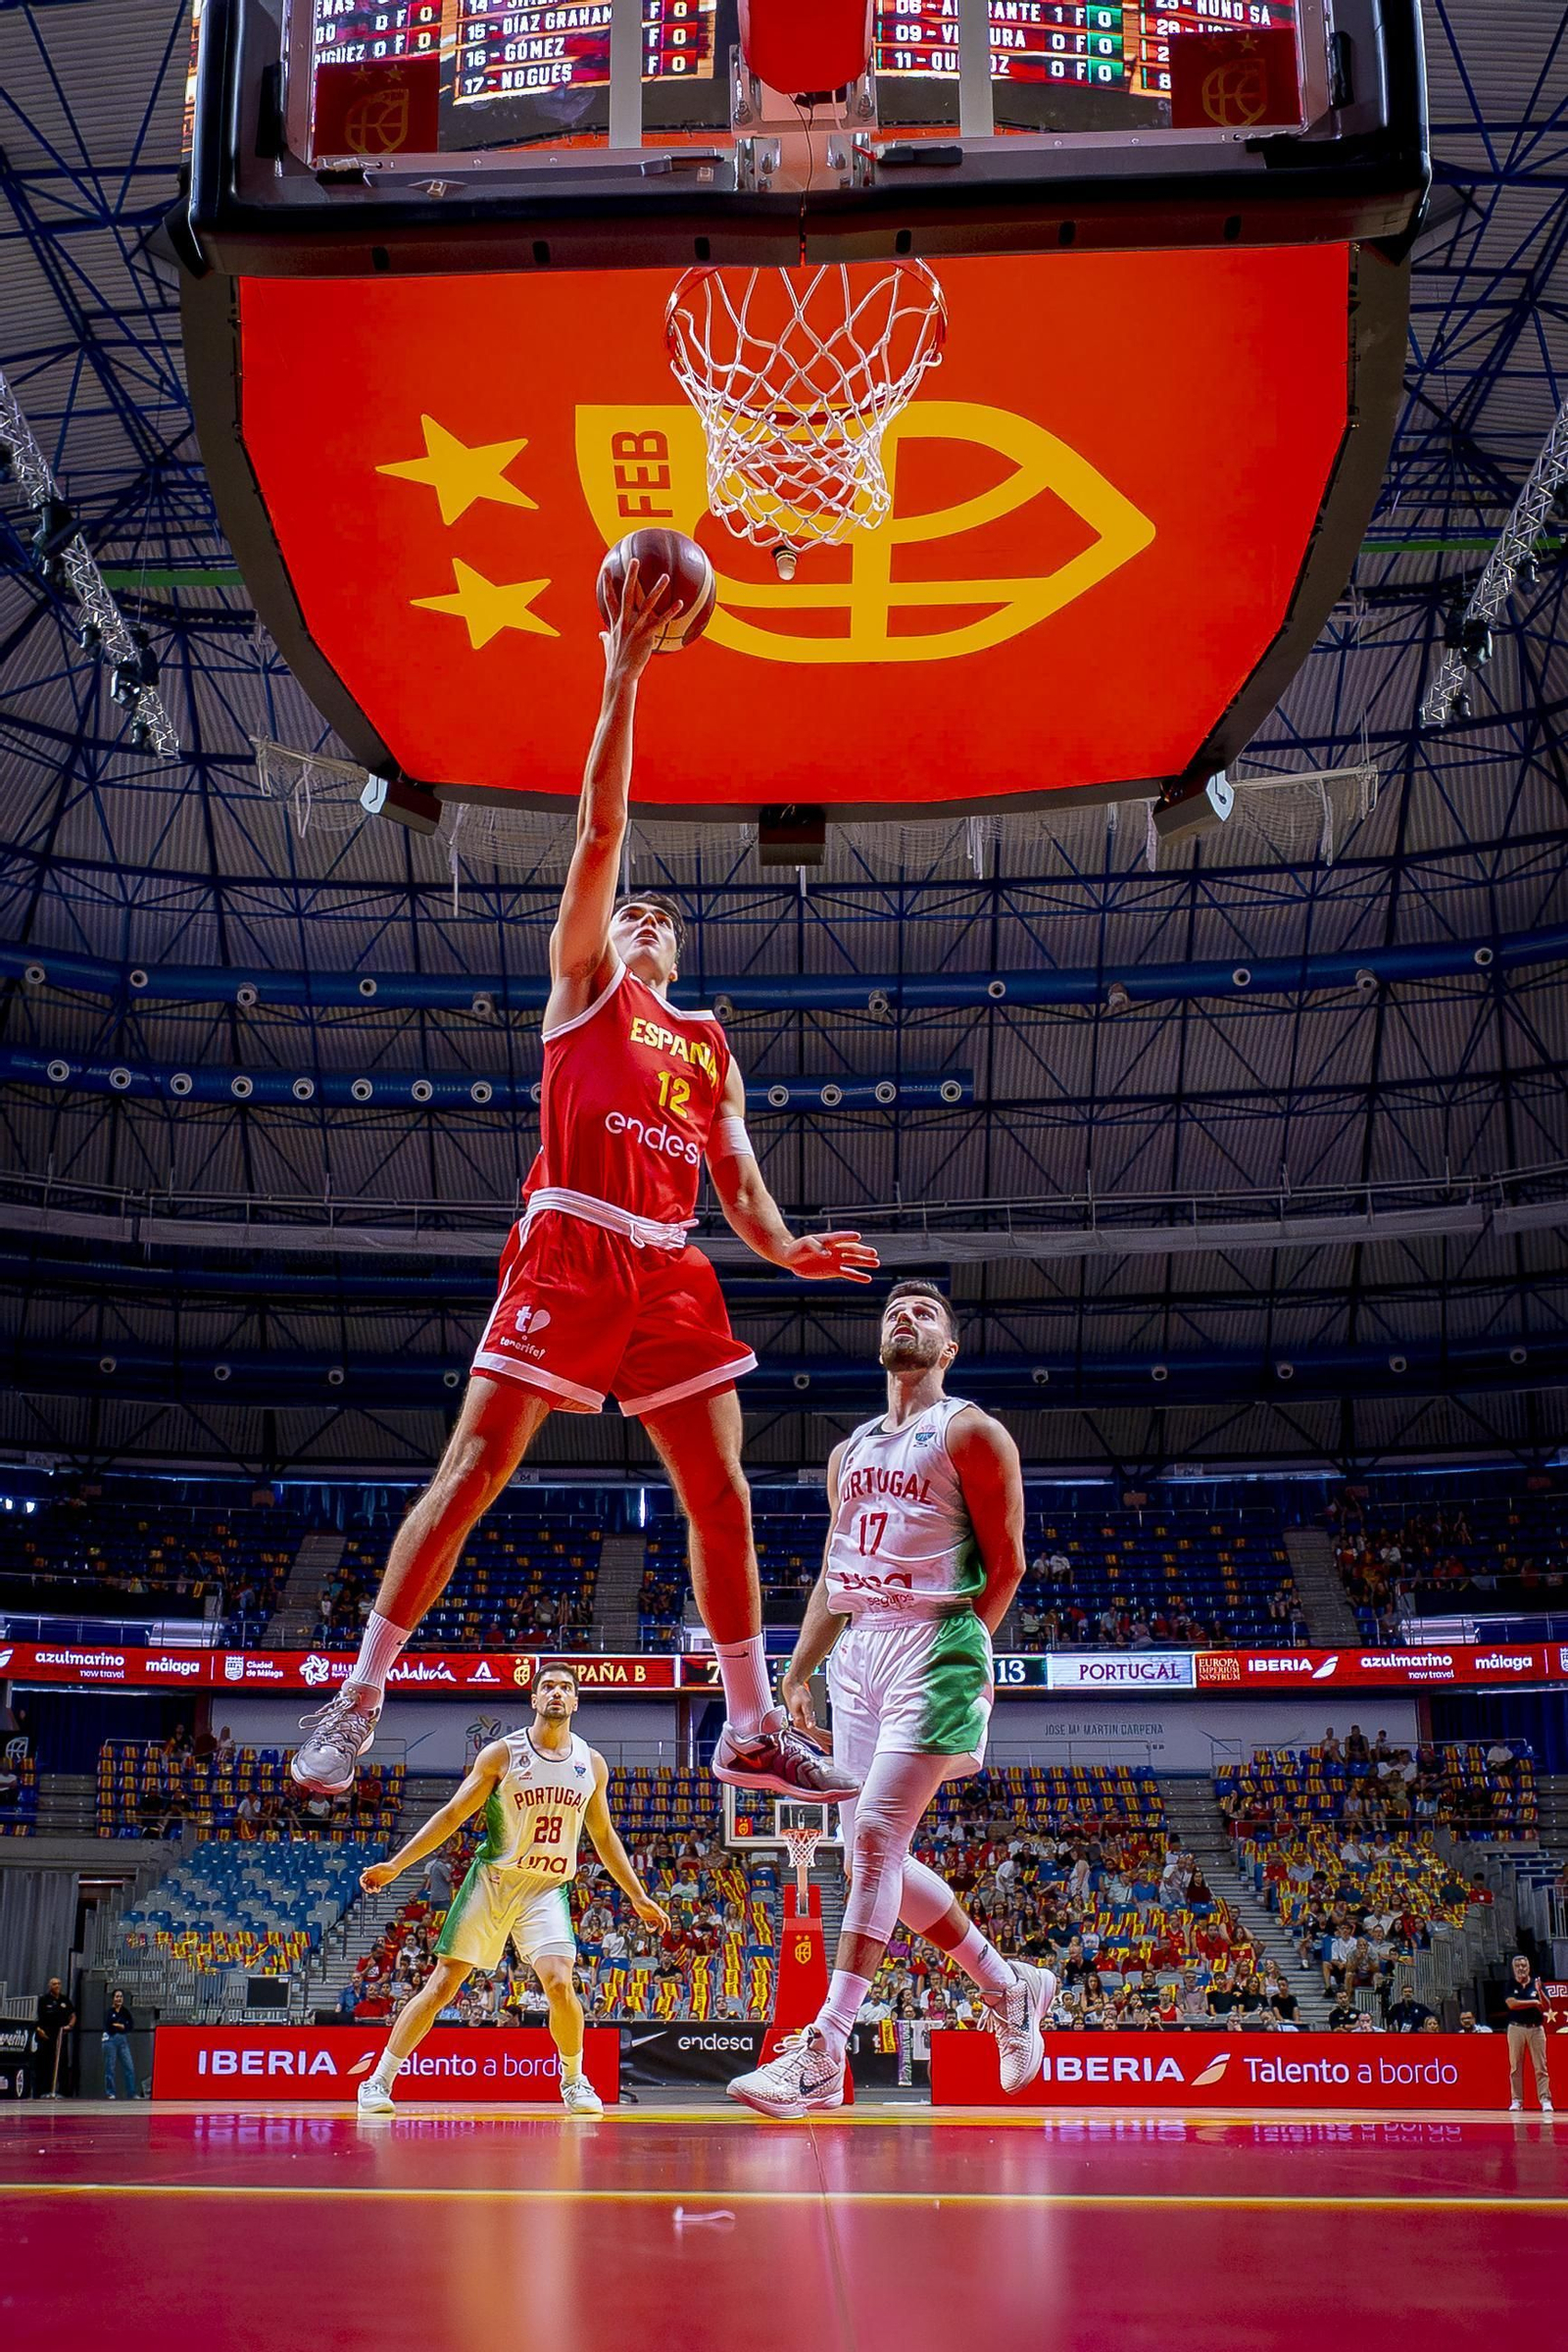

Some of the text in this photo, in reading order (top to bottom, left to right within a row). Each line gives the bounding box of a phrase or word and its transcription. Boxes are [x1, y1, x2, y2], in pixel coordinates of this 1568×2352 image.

[467, 24, 486, 40] 15
[503, 14, 540, 35] DÍAZ
[650, 2, 661, 19] F
[673, 2, 687, 18] 0
[1075, 7, 1085, 25] F
[1098, 11, 1111, 27] 0
[466, 50, 486, 67] 16
[505, 37, 565, 62] GÓMEZ
[649, 28, 660, 47] F
[672, 28, 686, 45] 0
[896, 24, 922, 41] 09
[1052, 33, 1065, 50] 0
[1076, 35, 1086, 52] F
[1099, 37, 1112, 54] 0
[465, 76, 484, 93] 17
[501, 63, 572, 89] NOGUÉS
[648, 56, 659, 74] F
[672, 56, 685, 72] 0
[895, 52, 911, 69] 11
[1052, 61, 1065, 77] 0
[1076, 62, 1086, 79] F
[1098, 65, 1111, 81] 0
[612, 430, 673, 517] FEB
[630, 1017, 717, 1088] ESPAÑA
[658, 1070, 690, 1118] 12
[605, 1111, 700, 1165] endes
[844, 1466, 932, 1505] RTUGAL
[858, 1512, 888, 1556] 17
[35, 1650, 124, 1666] azulmarino
[1199, 1658, 1240, 1667] EUROPA
[1248, 1659, 1313, 1672] IBERIA
[1360, 1653, 1453, 1668] azulmarino
[576, 1663, 647, 1682] PAÑA B
[998, 1660, 1026, 1684] 13
[1079, 1664, 1181, 1681] PORTUGAL
[514, 1787, 587, 1813] PORTUGAL
[534, 1816, 563, 1843] 28
[678, 2034, 753, 2051] endesa
[199, 2050, 337, 2075] IBERIA
[397, 2053, 566, 2077] alento a bord
[1043, 2057, 1184, 2082] IBERIA
[1244, 2057, 1458, 2084] Talento a bordo
